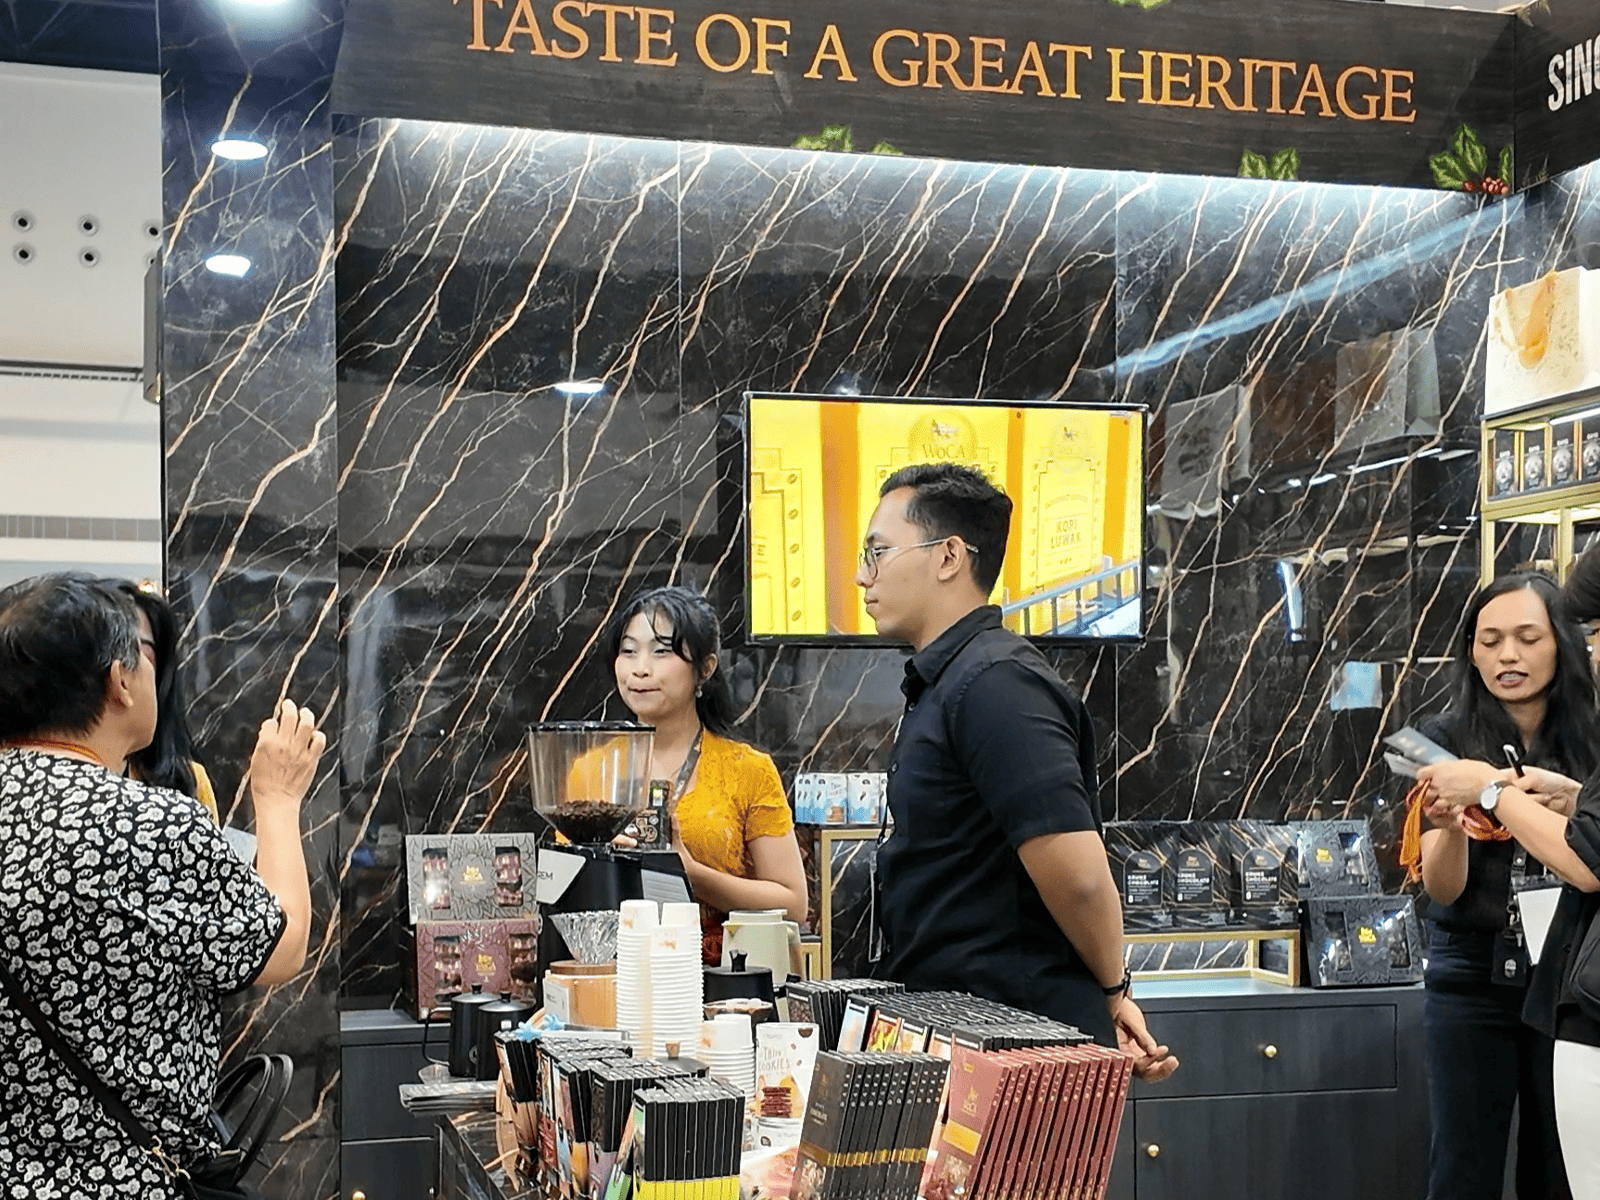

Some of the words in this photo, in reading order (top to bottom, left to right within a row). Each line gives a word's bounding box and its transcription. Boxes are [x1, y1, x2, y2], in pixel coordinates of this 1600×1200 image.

[453, 0, 678, 67] TASTE
[695, 13, 791, 75] OF
[803, 24, 858, 83] A
[872, 29, 1093, 100] GREAT
[1105, 47, 1417, 123] HERITAGE
